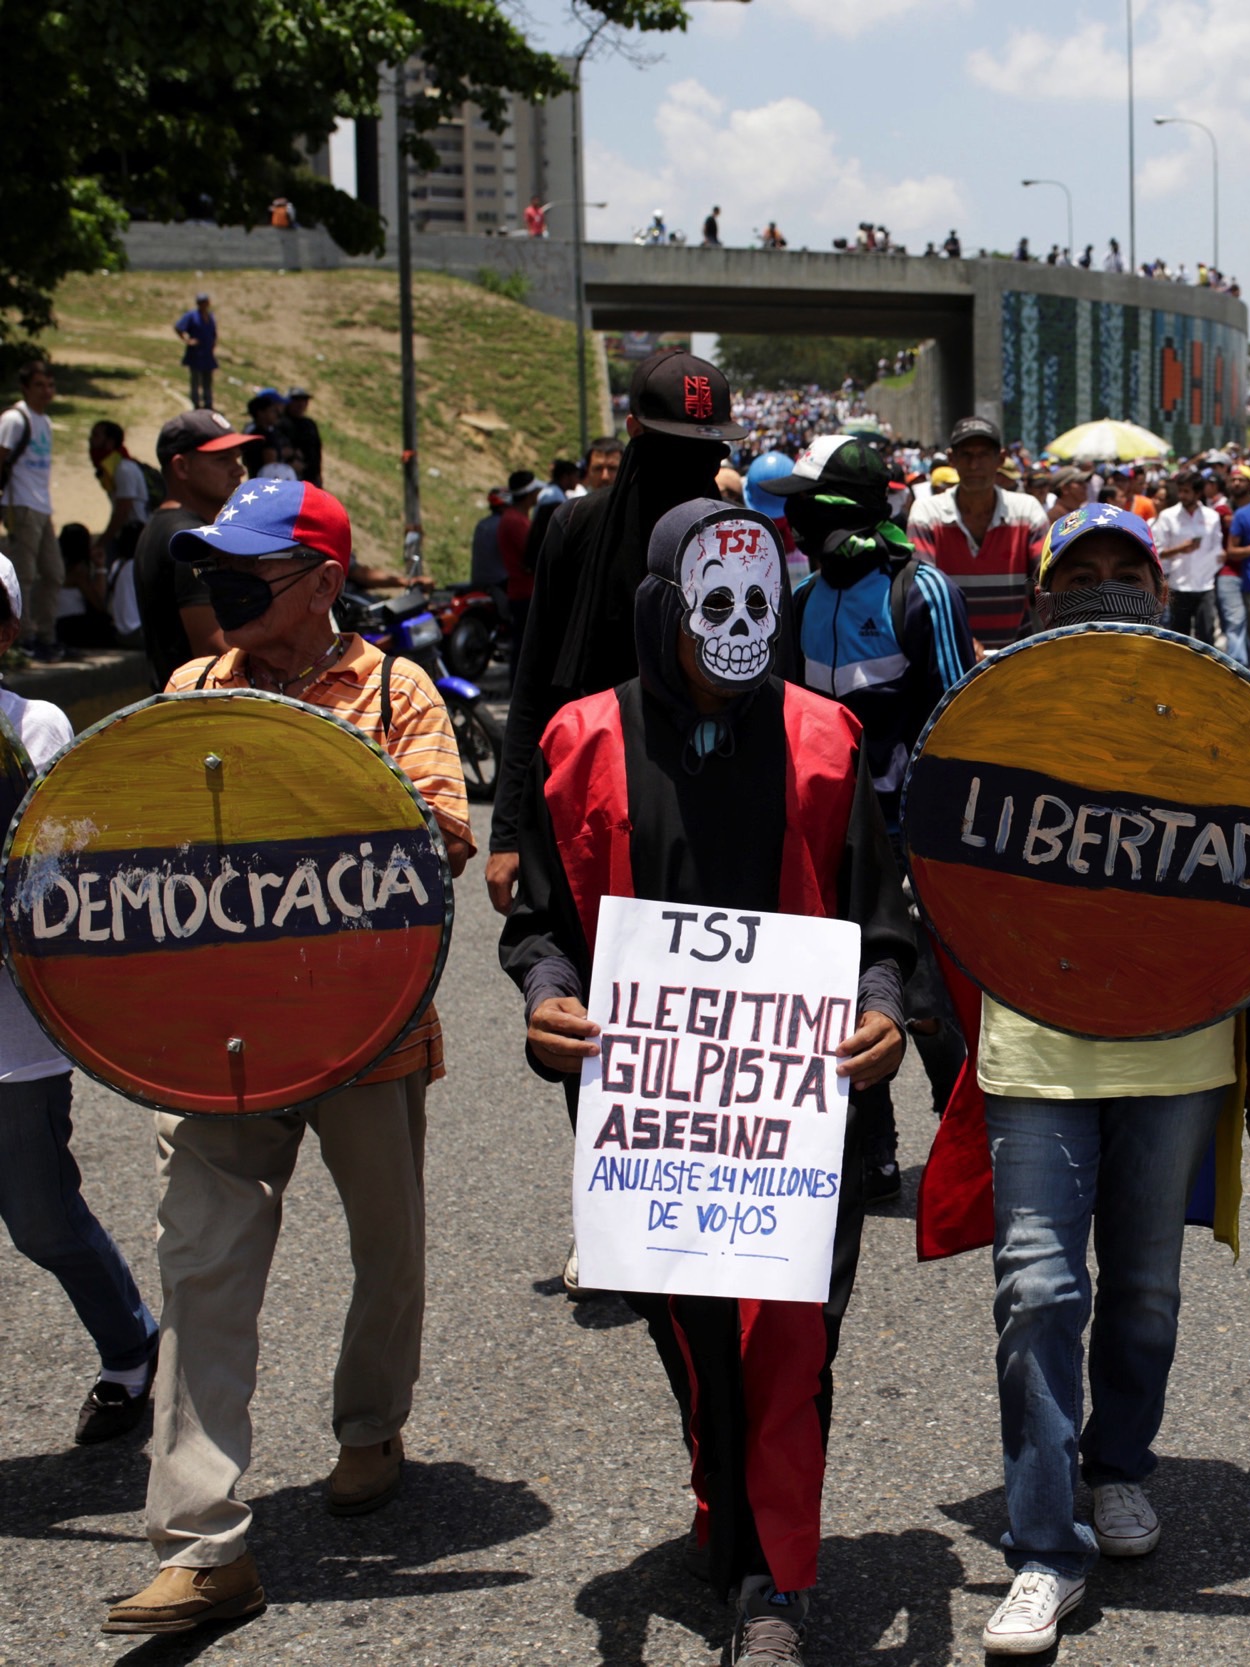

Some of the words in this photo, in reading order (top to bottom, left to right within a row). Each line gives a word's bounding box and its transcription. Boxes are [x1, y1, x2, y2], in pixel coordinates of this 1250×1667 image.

[716, 529, 760, 554] TSJ
[662, 911, 761, 964] TSJ
[608, 981, 852, 1056] ILEGITIMO
[601, 1034, 828, 1114] GOLPISTA
[593, 1104, 792, 1160] ASESINO
[709, 1166, 737, 1192] 14
[741, 1168, 838, 1199] MILLONES
[648, 1201, 684, 1231] DE
